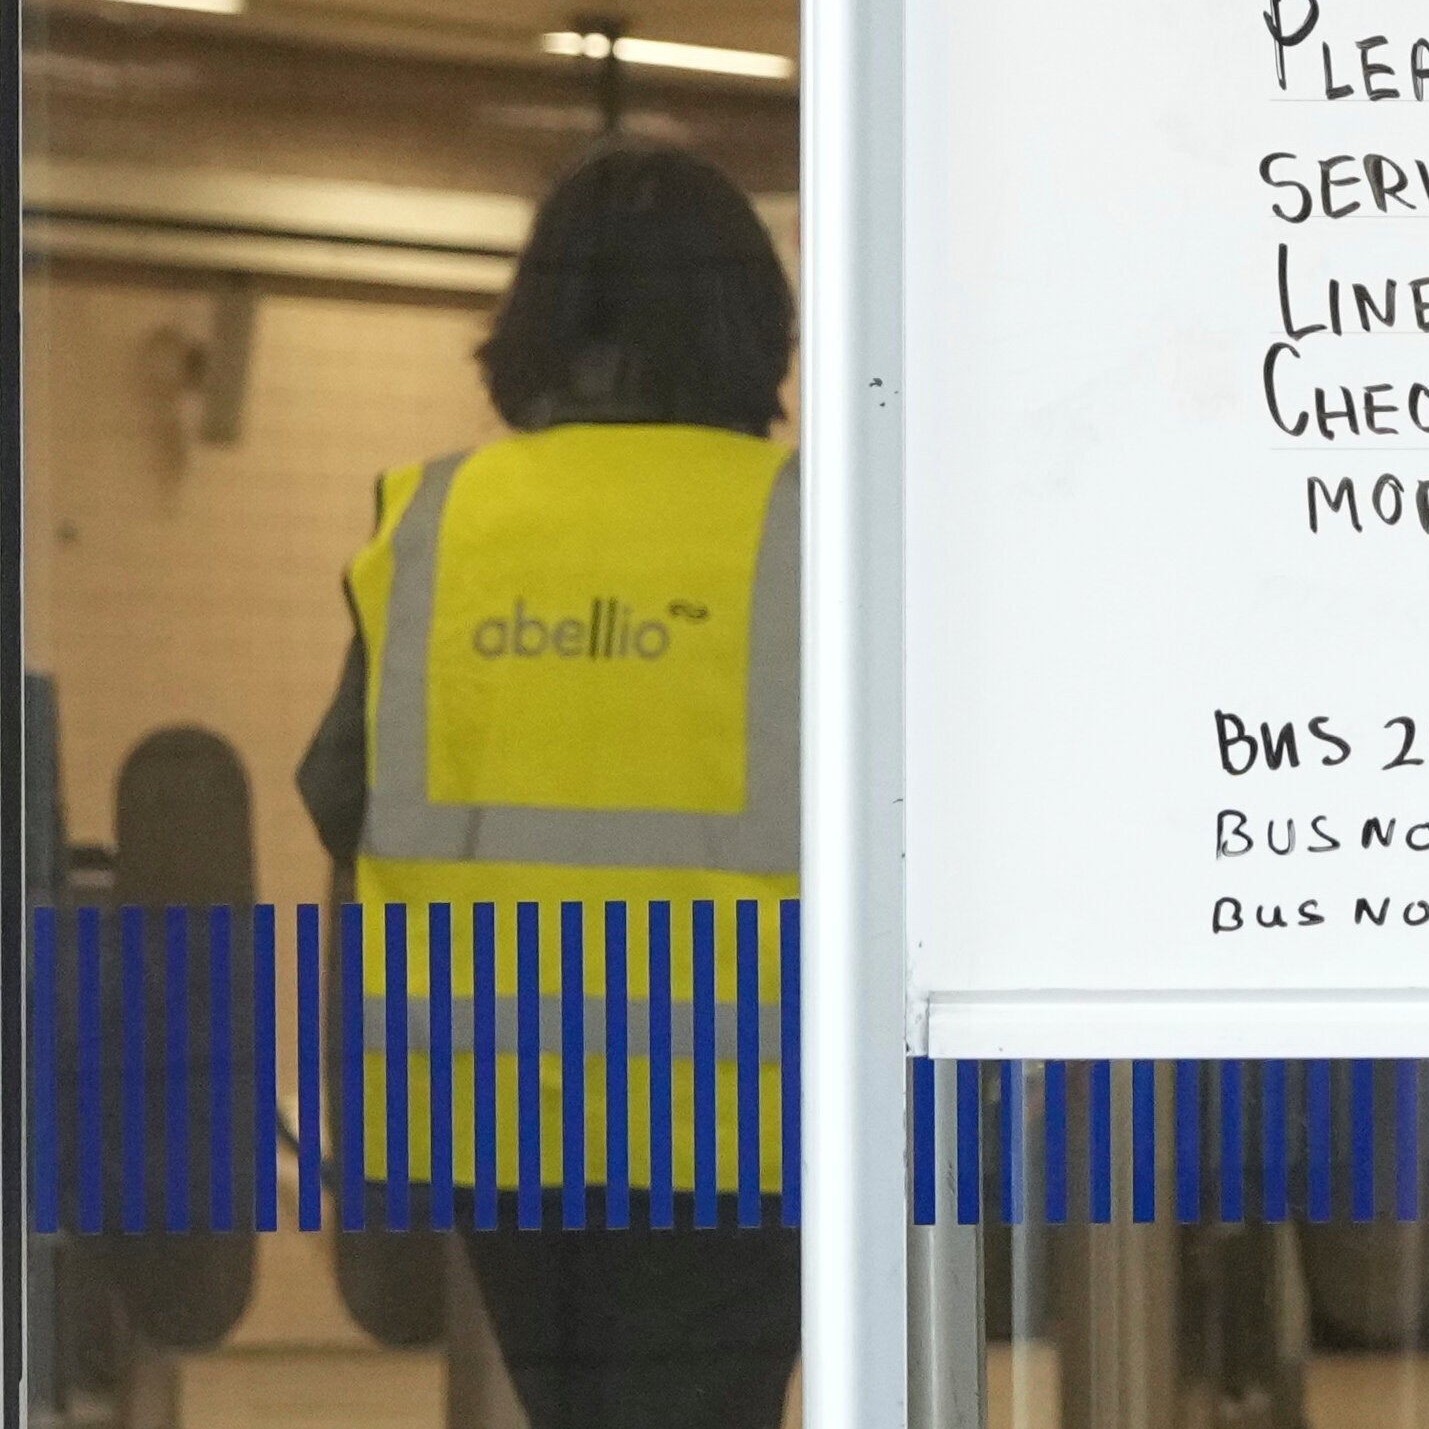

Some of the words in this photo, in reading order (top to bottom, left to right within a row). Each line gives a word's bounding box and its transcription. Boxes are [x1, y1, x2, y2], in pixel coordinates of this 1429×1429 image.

[472, 597, 671, 662] abellio
[1215, 710, 1351, 775] BUS
[1216, 809, 1340, 857] BUS
[1213, 897, 1324, 934] BUS
